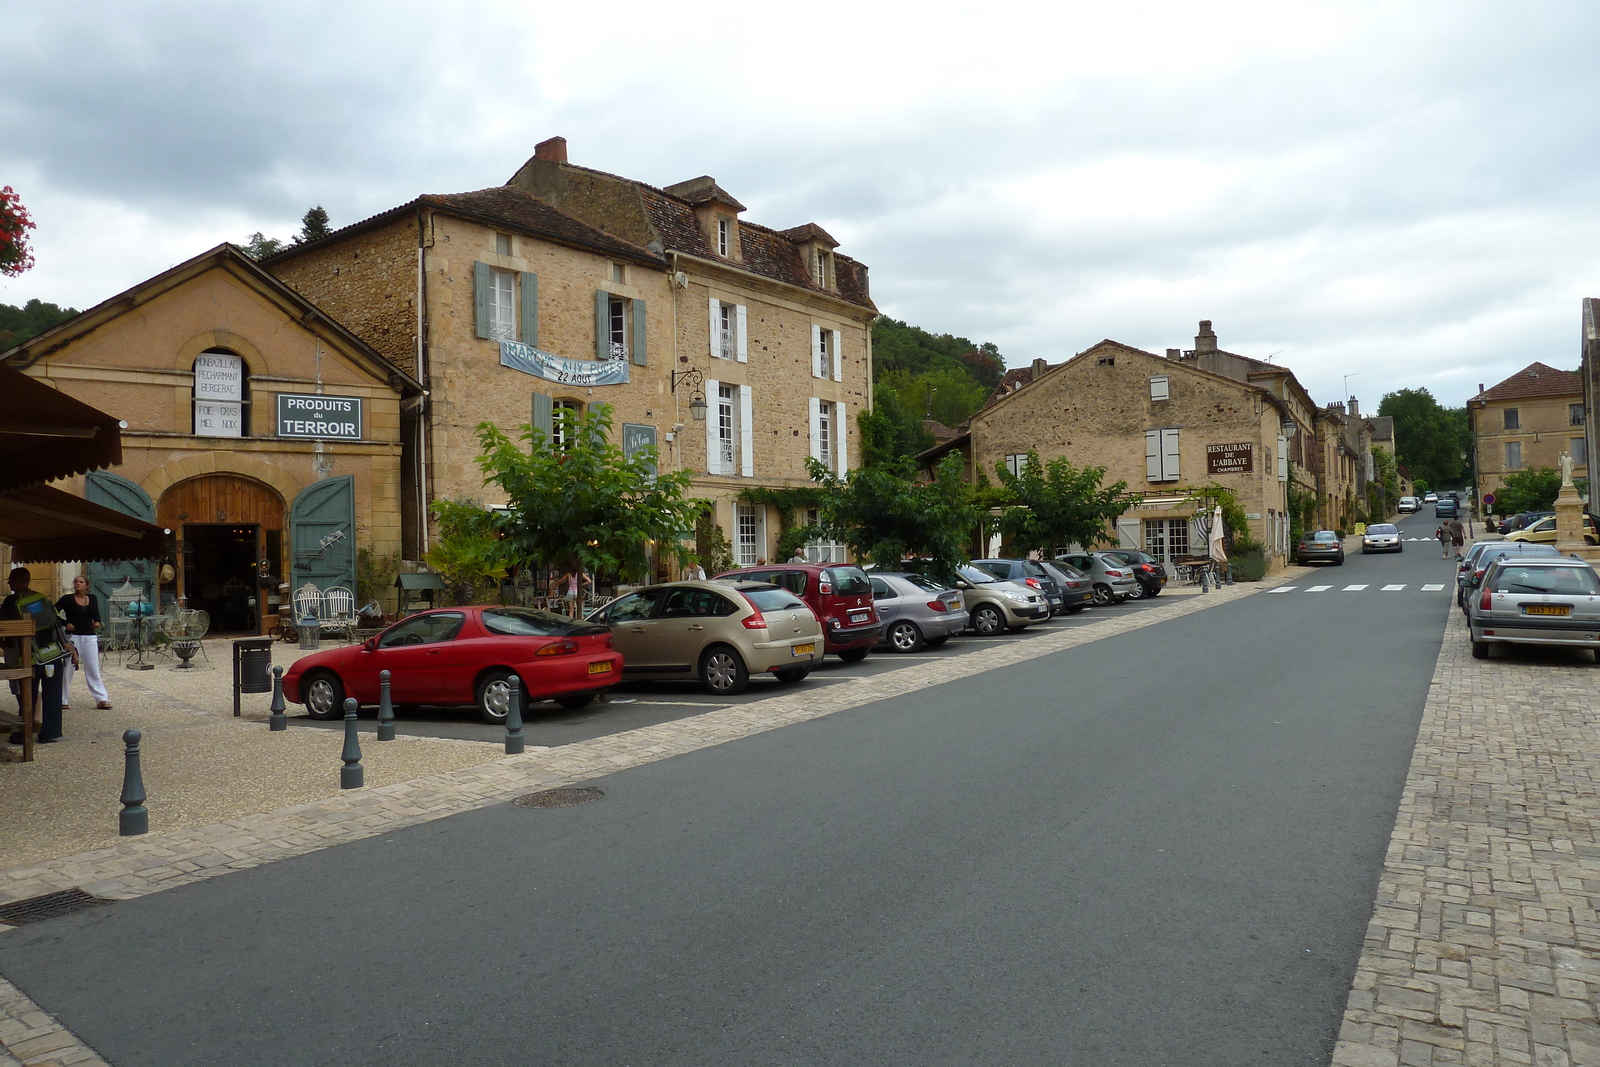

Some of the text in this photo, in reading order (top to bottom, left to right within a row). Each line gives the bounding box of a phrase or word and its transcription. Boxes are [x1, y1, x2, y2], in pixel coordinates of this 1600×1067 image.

[196, 357, 238, 369] MONBAZILLAC
[562, 361, 583, 373] AUX
[590, 362, 624, 374] PUCES
[198, 370, 238, 381] PECHARMANT
[557, 371, 591, 384] 22 AOUT
[201, 383, 235, 393] BERGERAC
[288, 399, 351, 412] PRODUITS
[199, 406, 238, 416] FOIE GRAS
[200, 419, 237, 429] MIEL NOIX
[284, 420, 355, 435] TERROIR
[1207, 444, 1251, 453] RESTAURANT
[1213, 458, 1247, 467] L'ABBAYE
[1528, 606, 1566, 615] 3649 TJ 24
